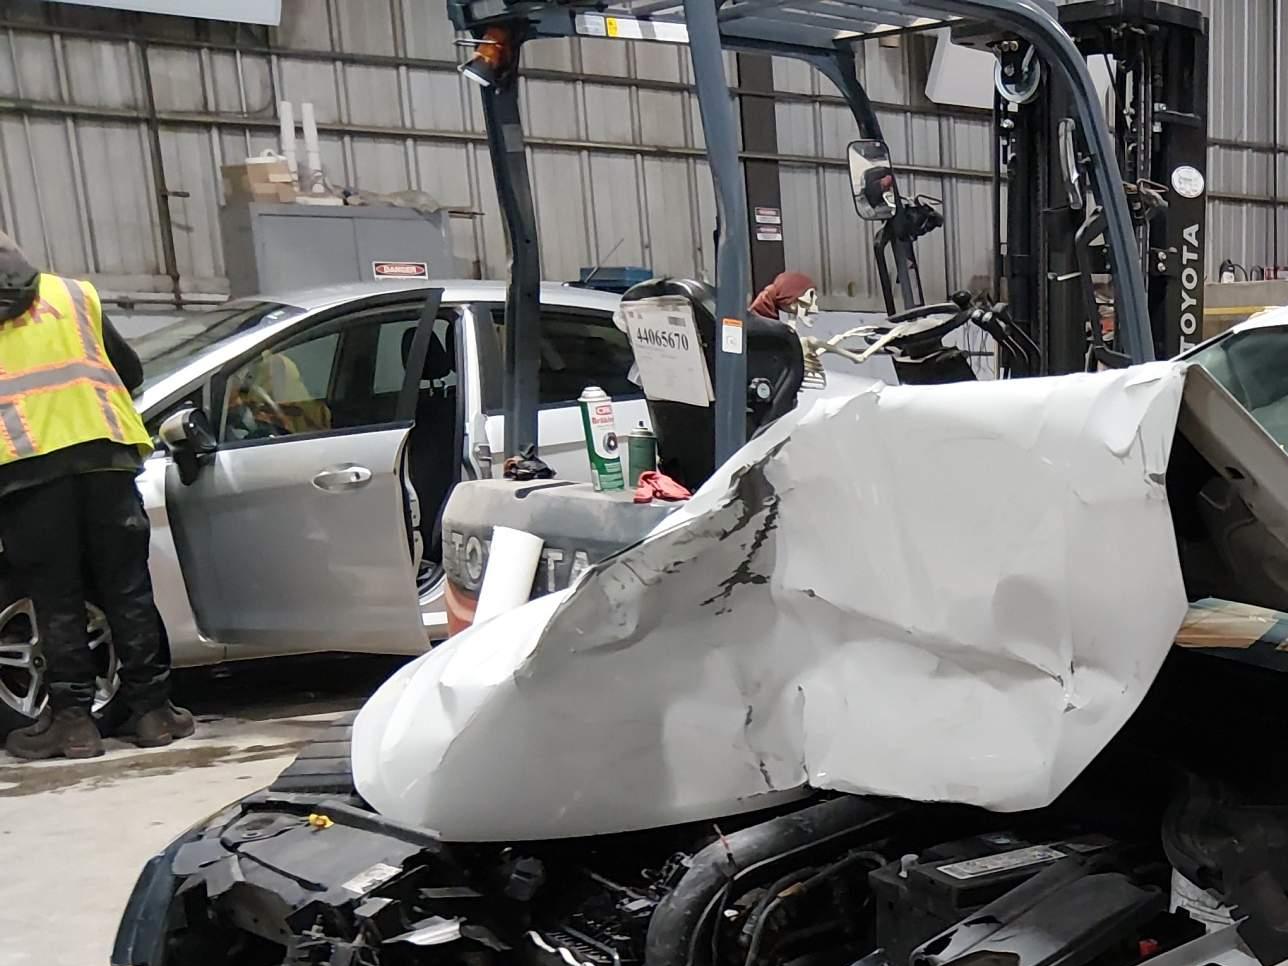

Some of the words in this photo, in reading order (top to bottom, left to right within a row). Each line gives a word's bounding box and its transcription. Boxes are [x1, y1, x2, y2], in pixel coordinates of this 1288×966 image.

[1180, 223, 1200, 354] TOYOTA
[636, 327, 689, 351] 44065670
[450, 532, 593, 592] TOTA
